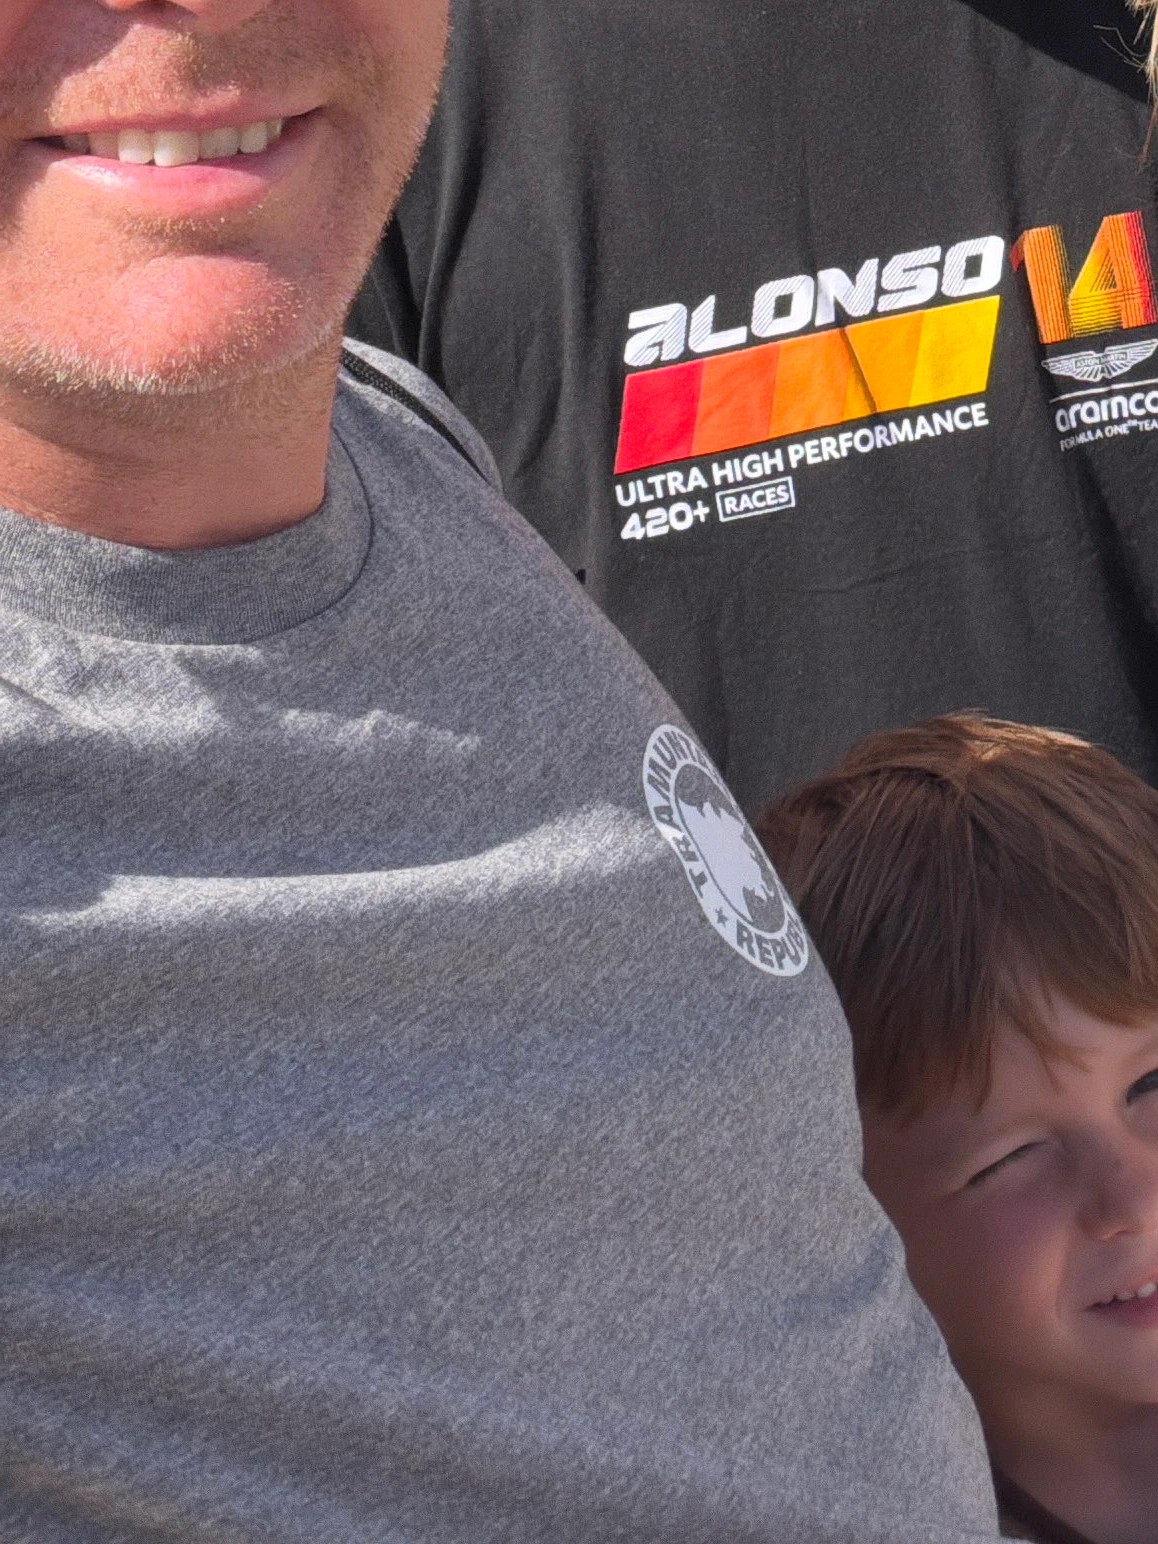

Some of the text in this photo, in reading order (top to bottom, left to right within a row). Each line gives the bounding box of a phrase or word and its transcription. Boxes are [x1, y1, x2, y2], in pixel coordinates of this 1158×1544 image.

[615, 402, 990, 507] ULTRA HIGH PERFORMANCE
[1060, 428, 1104, 452] FORMULA
[620, 485, 791, 541] 420+ RACES
